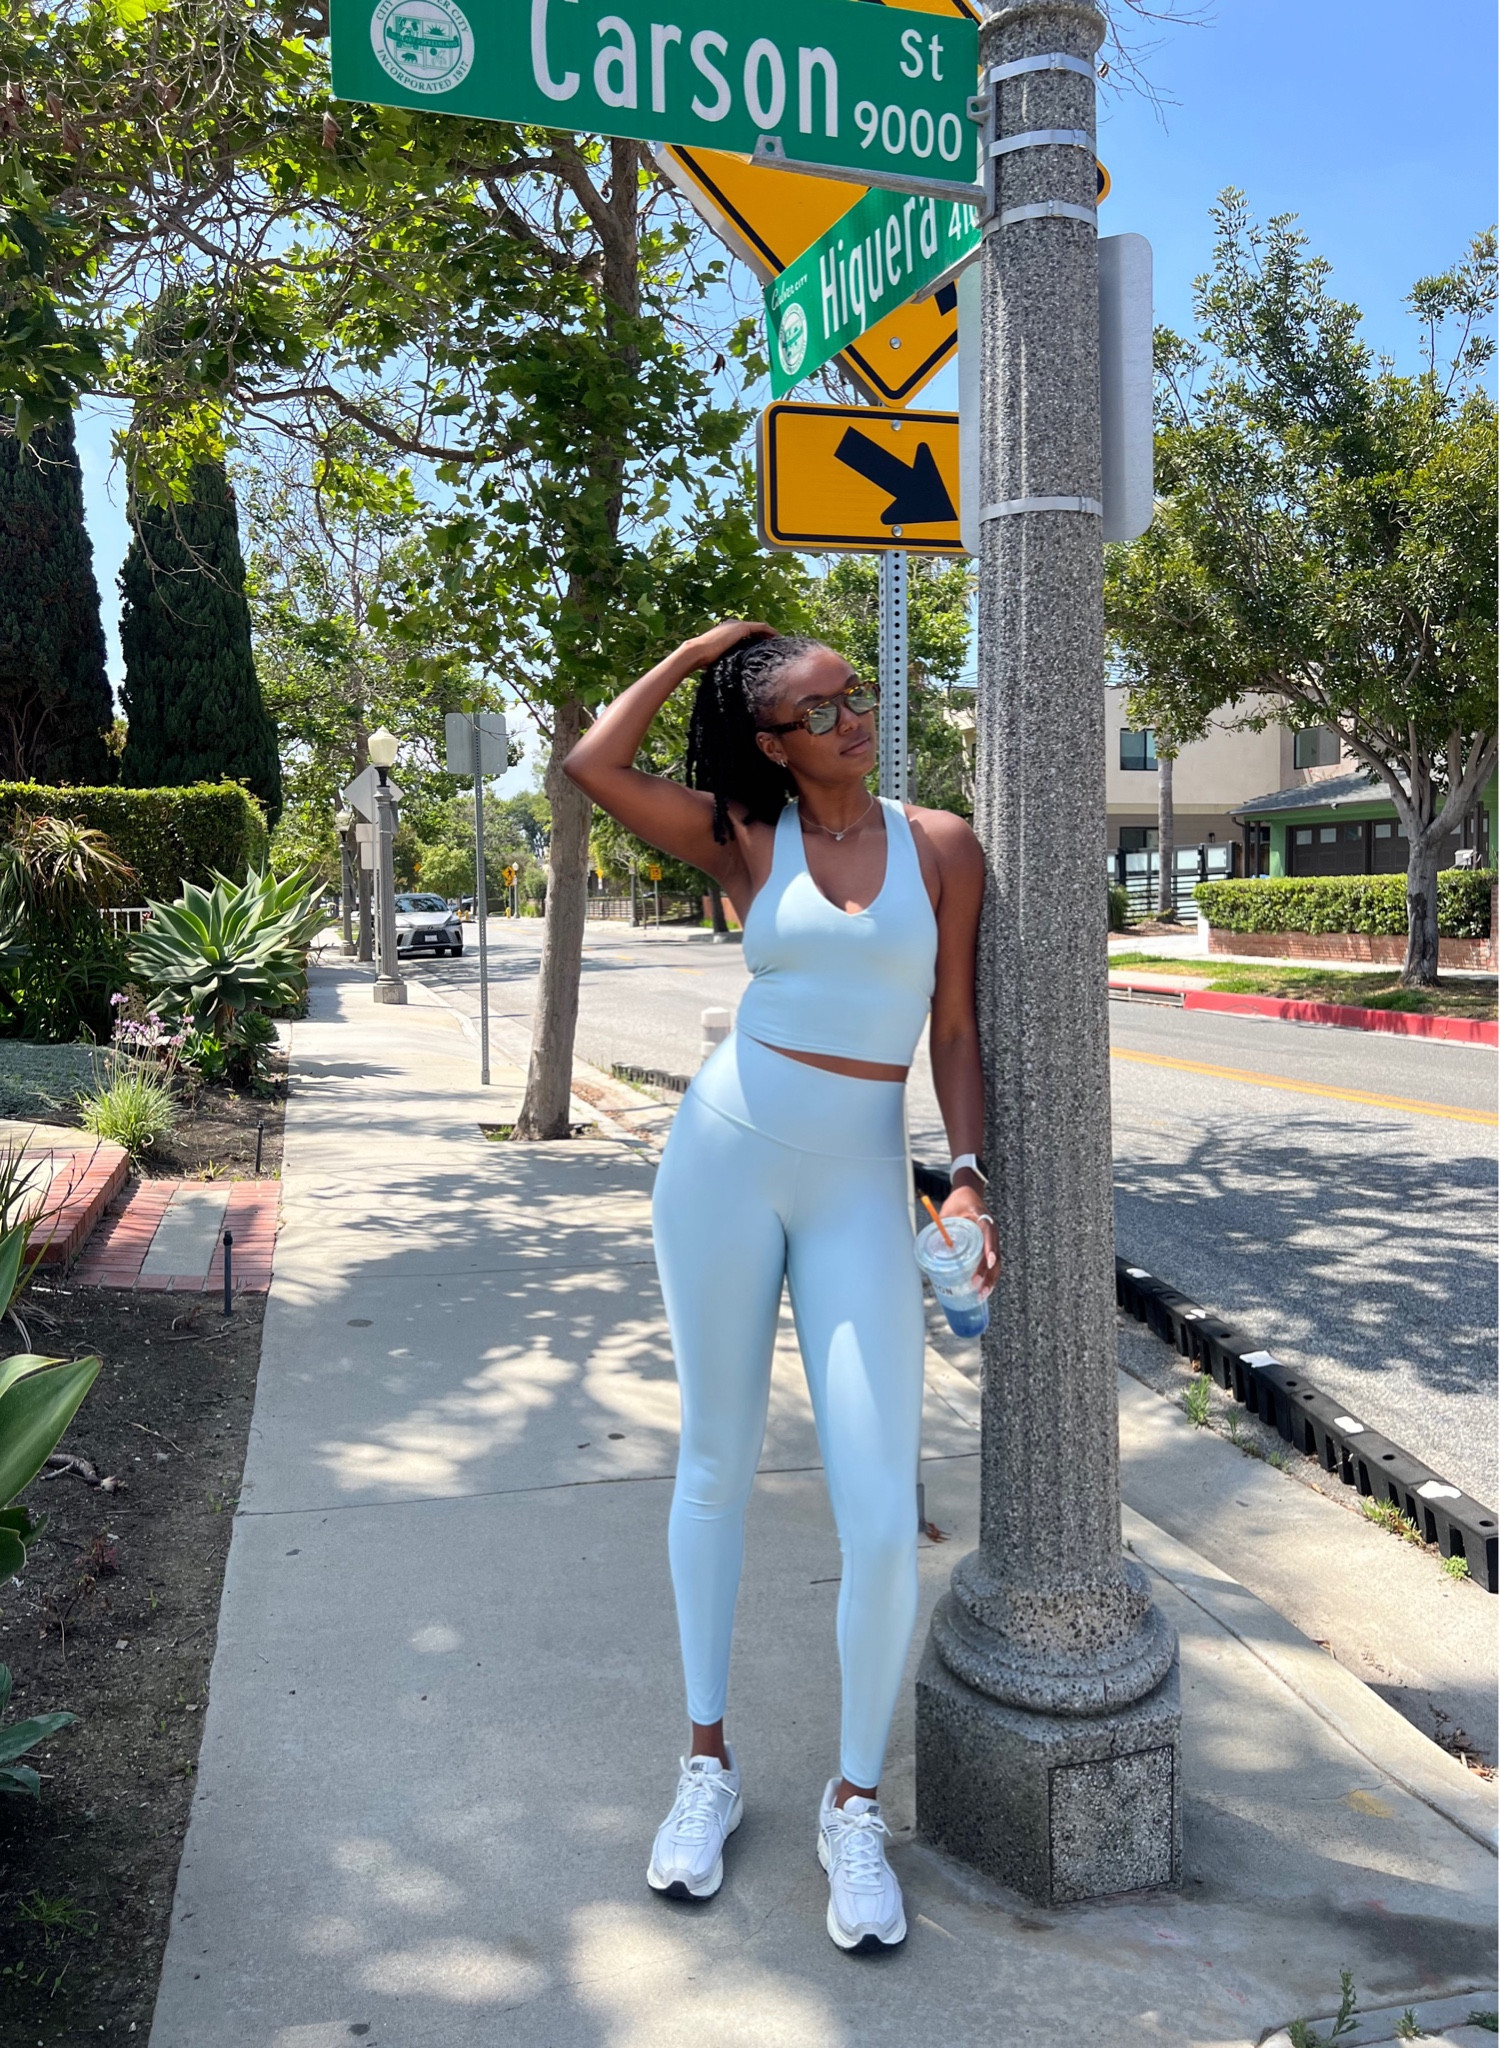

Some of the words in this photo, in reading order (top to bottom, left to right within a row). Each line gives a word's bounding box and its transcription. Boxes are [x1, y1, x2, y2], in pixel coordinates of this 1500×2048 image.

[451, 8, 469, 32] CITY
[376, 49, 452, 91] INCORPORATED
[453, 60, 469, 81] 1917
[530, 0, 839, 138] Carson
[899, 28, 944, 82] St
[853, 100, 963, 162] 9000
[819, 196, 939, 340] Higuera
